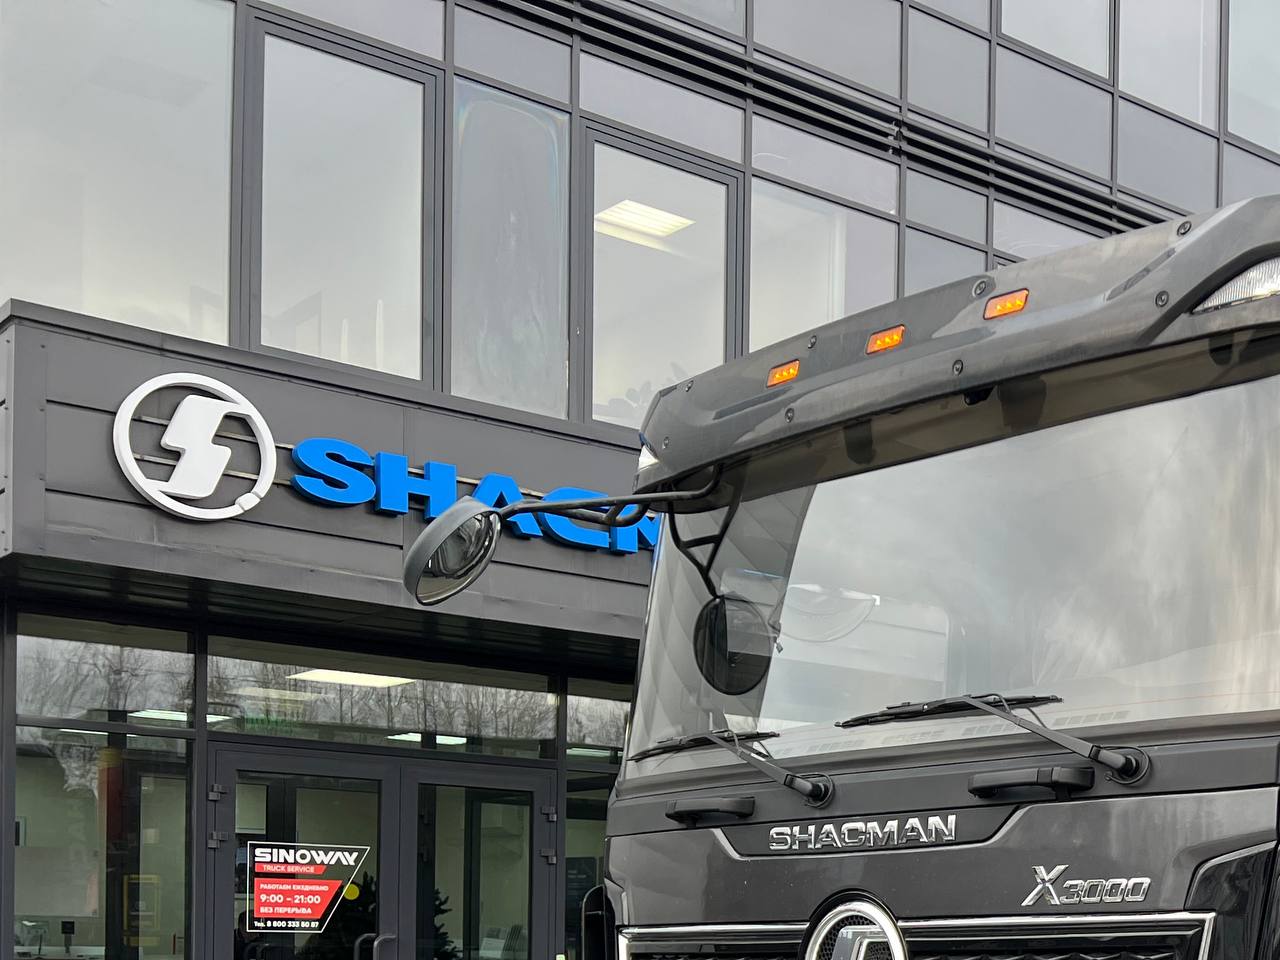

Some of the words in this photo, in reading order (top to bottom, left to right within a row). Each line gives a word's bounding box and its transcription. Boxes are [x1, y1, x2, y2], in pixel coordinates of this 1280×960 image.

[768, 814, 957, 851] SHACMAN
[254, 847, 359, 866] SINOWAY
[263, 864, 286, 872] TRUCK
[287, 865, 315, 873] SERVICE
[260, 883, 291, 891] РАБОТАЕМ
[1020, 864, 1152, 907] X3000
[260, 894, 284, 903] 9:00
[294, 894, 321, 904] 21:00
